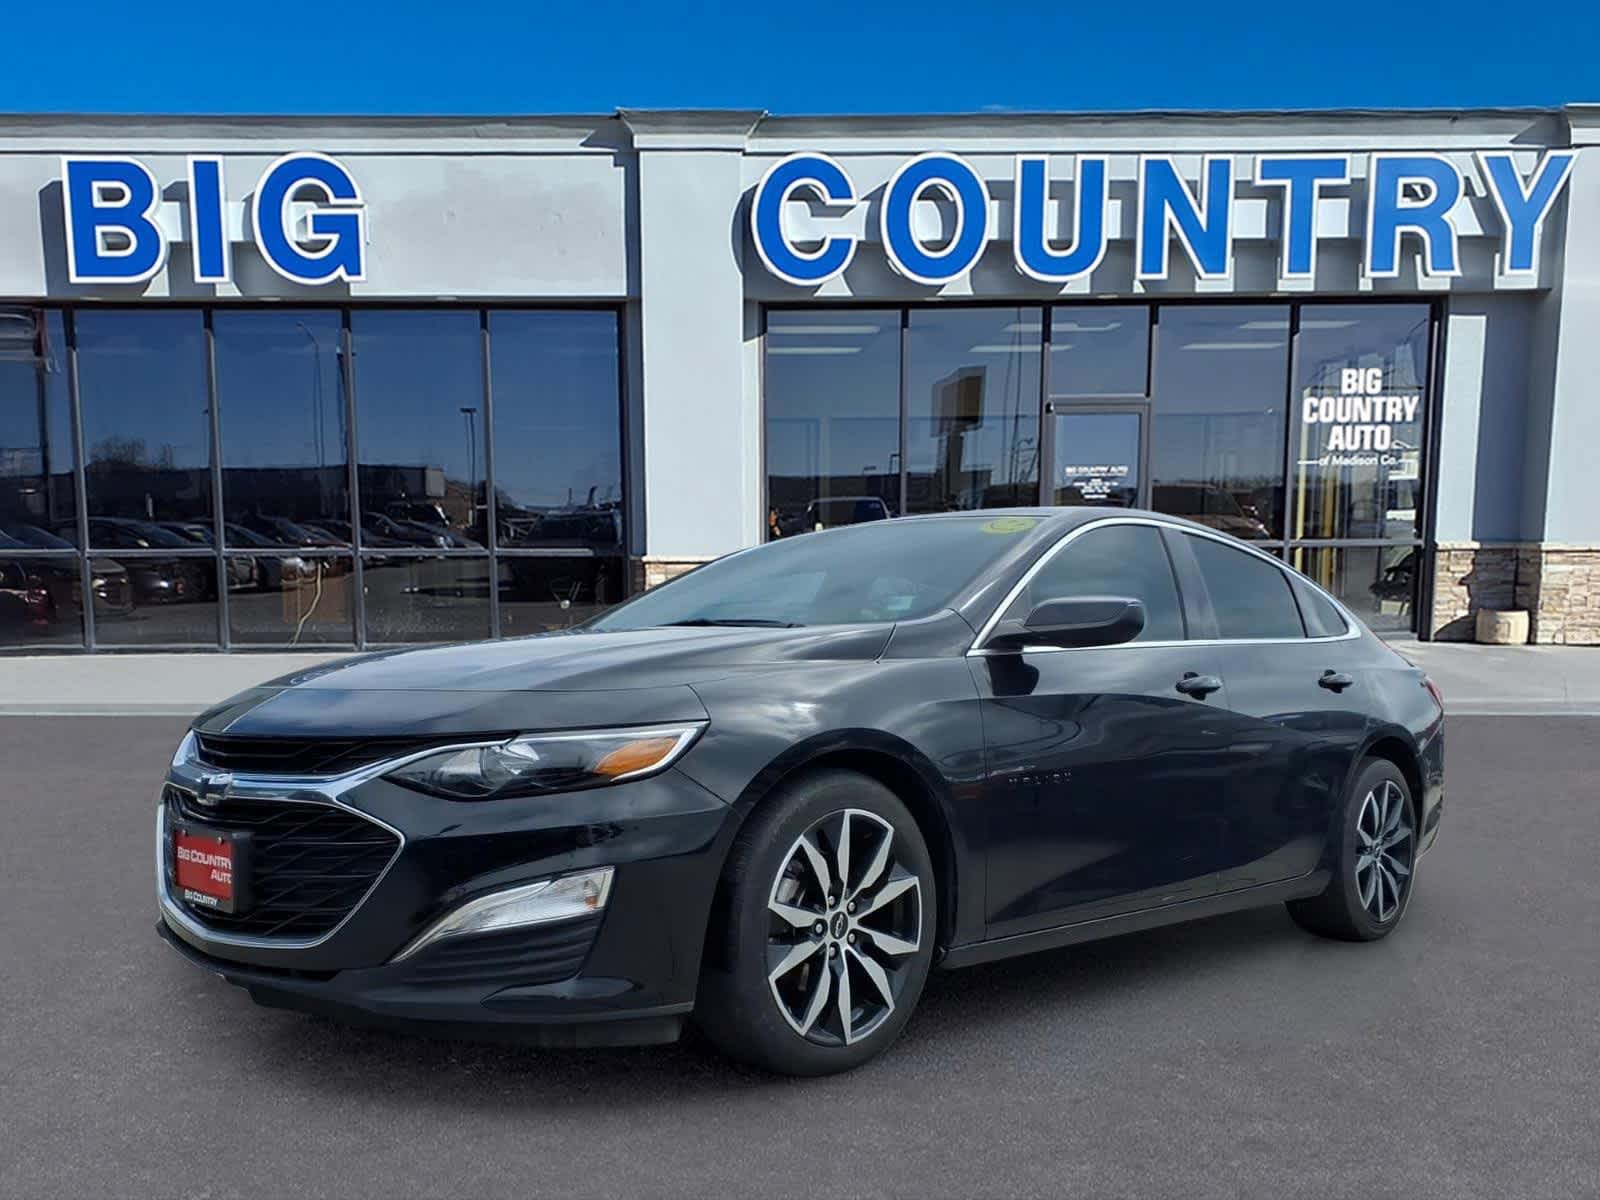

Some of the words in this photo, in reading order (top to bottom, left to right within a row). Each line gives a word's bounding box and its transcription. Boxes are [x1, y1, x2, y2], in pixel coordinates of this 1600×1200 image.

[61, 152, 367, 285] BIG
[751, 151, 1575, 285] COUNTRY
[1341, 367, 1383, 395] BIG
[1302, 395, 1420, 423] COUNTRY
[1327, 423, 1392, 451] AUTO
[1319, 456, 1329, 466] of
[1331, 455, 1378, 465] Madison
[178, 847, 190, 860] BIG
[193, 891, 218, 905] COUNTRY
